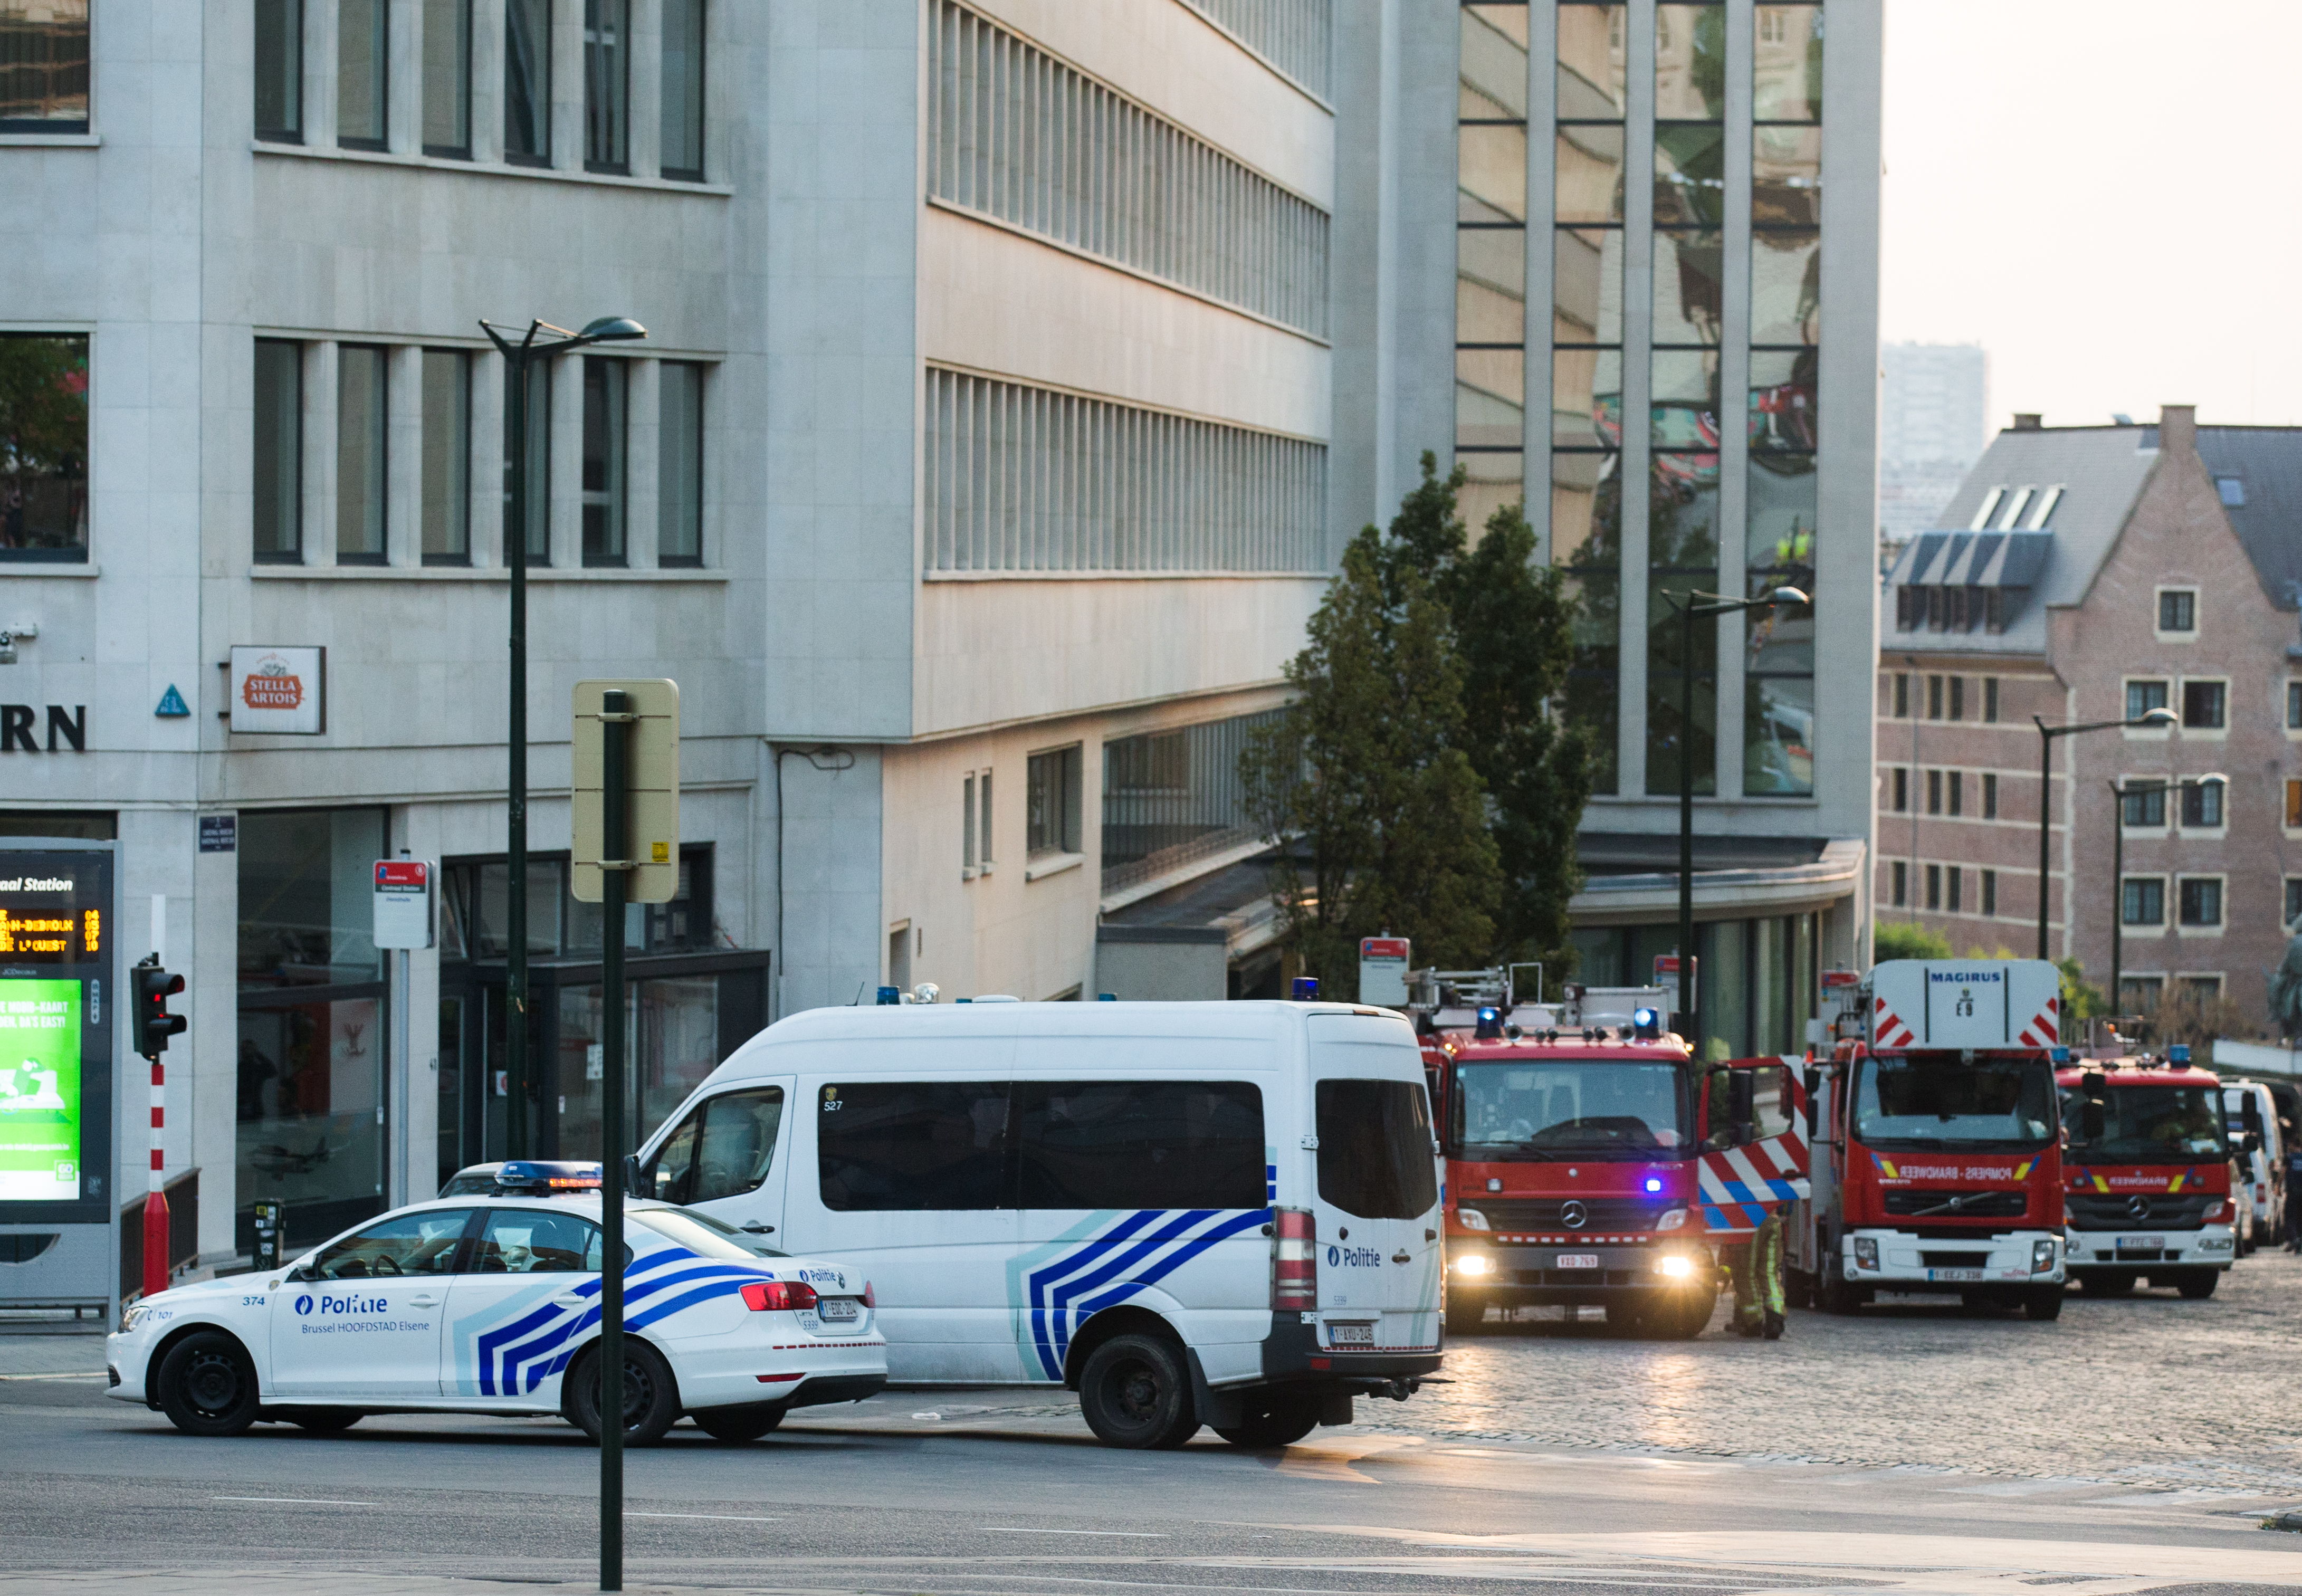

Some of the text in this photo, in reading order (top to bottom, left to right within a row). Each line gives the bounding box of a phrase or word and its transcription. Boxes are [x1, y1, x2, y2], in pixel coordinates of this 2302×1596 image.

[250, 680, 295, 691] STELLA
[250, 692, 297, 704] ARTOIS
[0, 705, 86, 752] RN
[24, 877, 73, 891] Station
[85, 910, 99, 921] 04
[85, 920, 100, 932] 05
[85, 930, 100, 942] 07
[19, 940, 66, 952] L'OUEST
[86, 940, 99, 952] 10
[1931, 971, 2001, 983] MAGIRUS
[8, 1001, 68, 1014] MOBIB-KAART
[19, 1016, 39, 1028] DA'S
[41, 1016, 66, 1028] EASY!
[824, 1101, 843, 1112] 527
[1344, 1247, 1380, 1267] Politie
[810, 1269, 836, 1282] Politie
[243, 1297, 265, 1306] 374
[158, 1311, 173, 1320] 101
[302, 1321, 429, 1334] Brussel HOOFDSTAD Elsene
[803, 1320, 819, 1330] 5339
